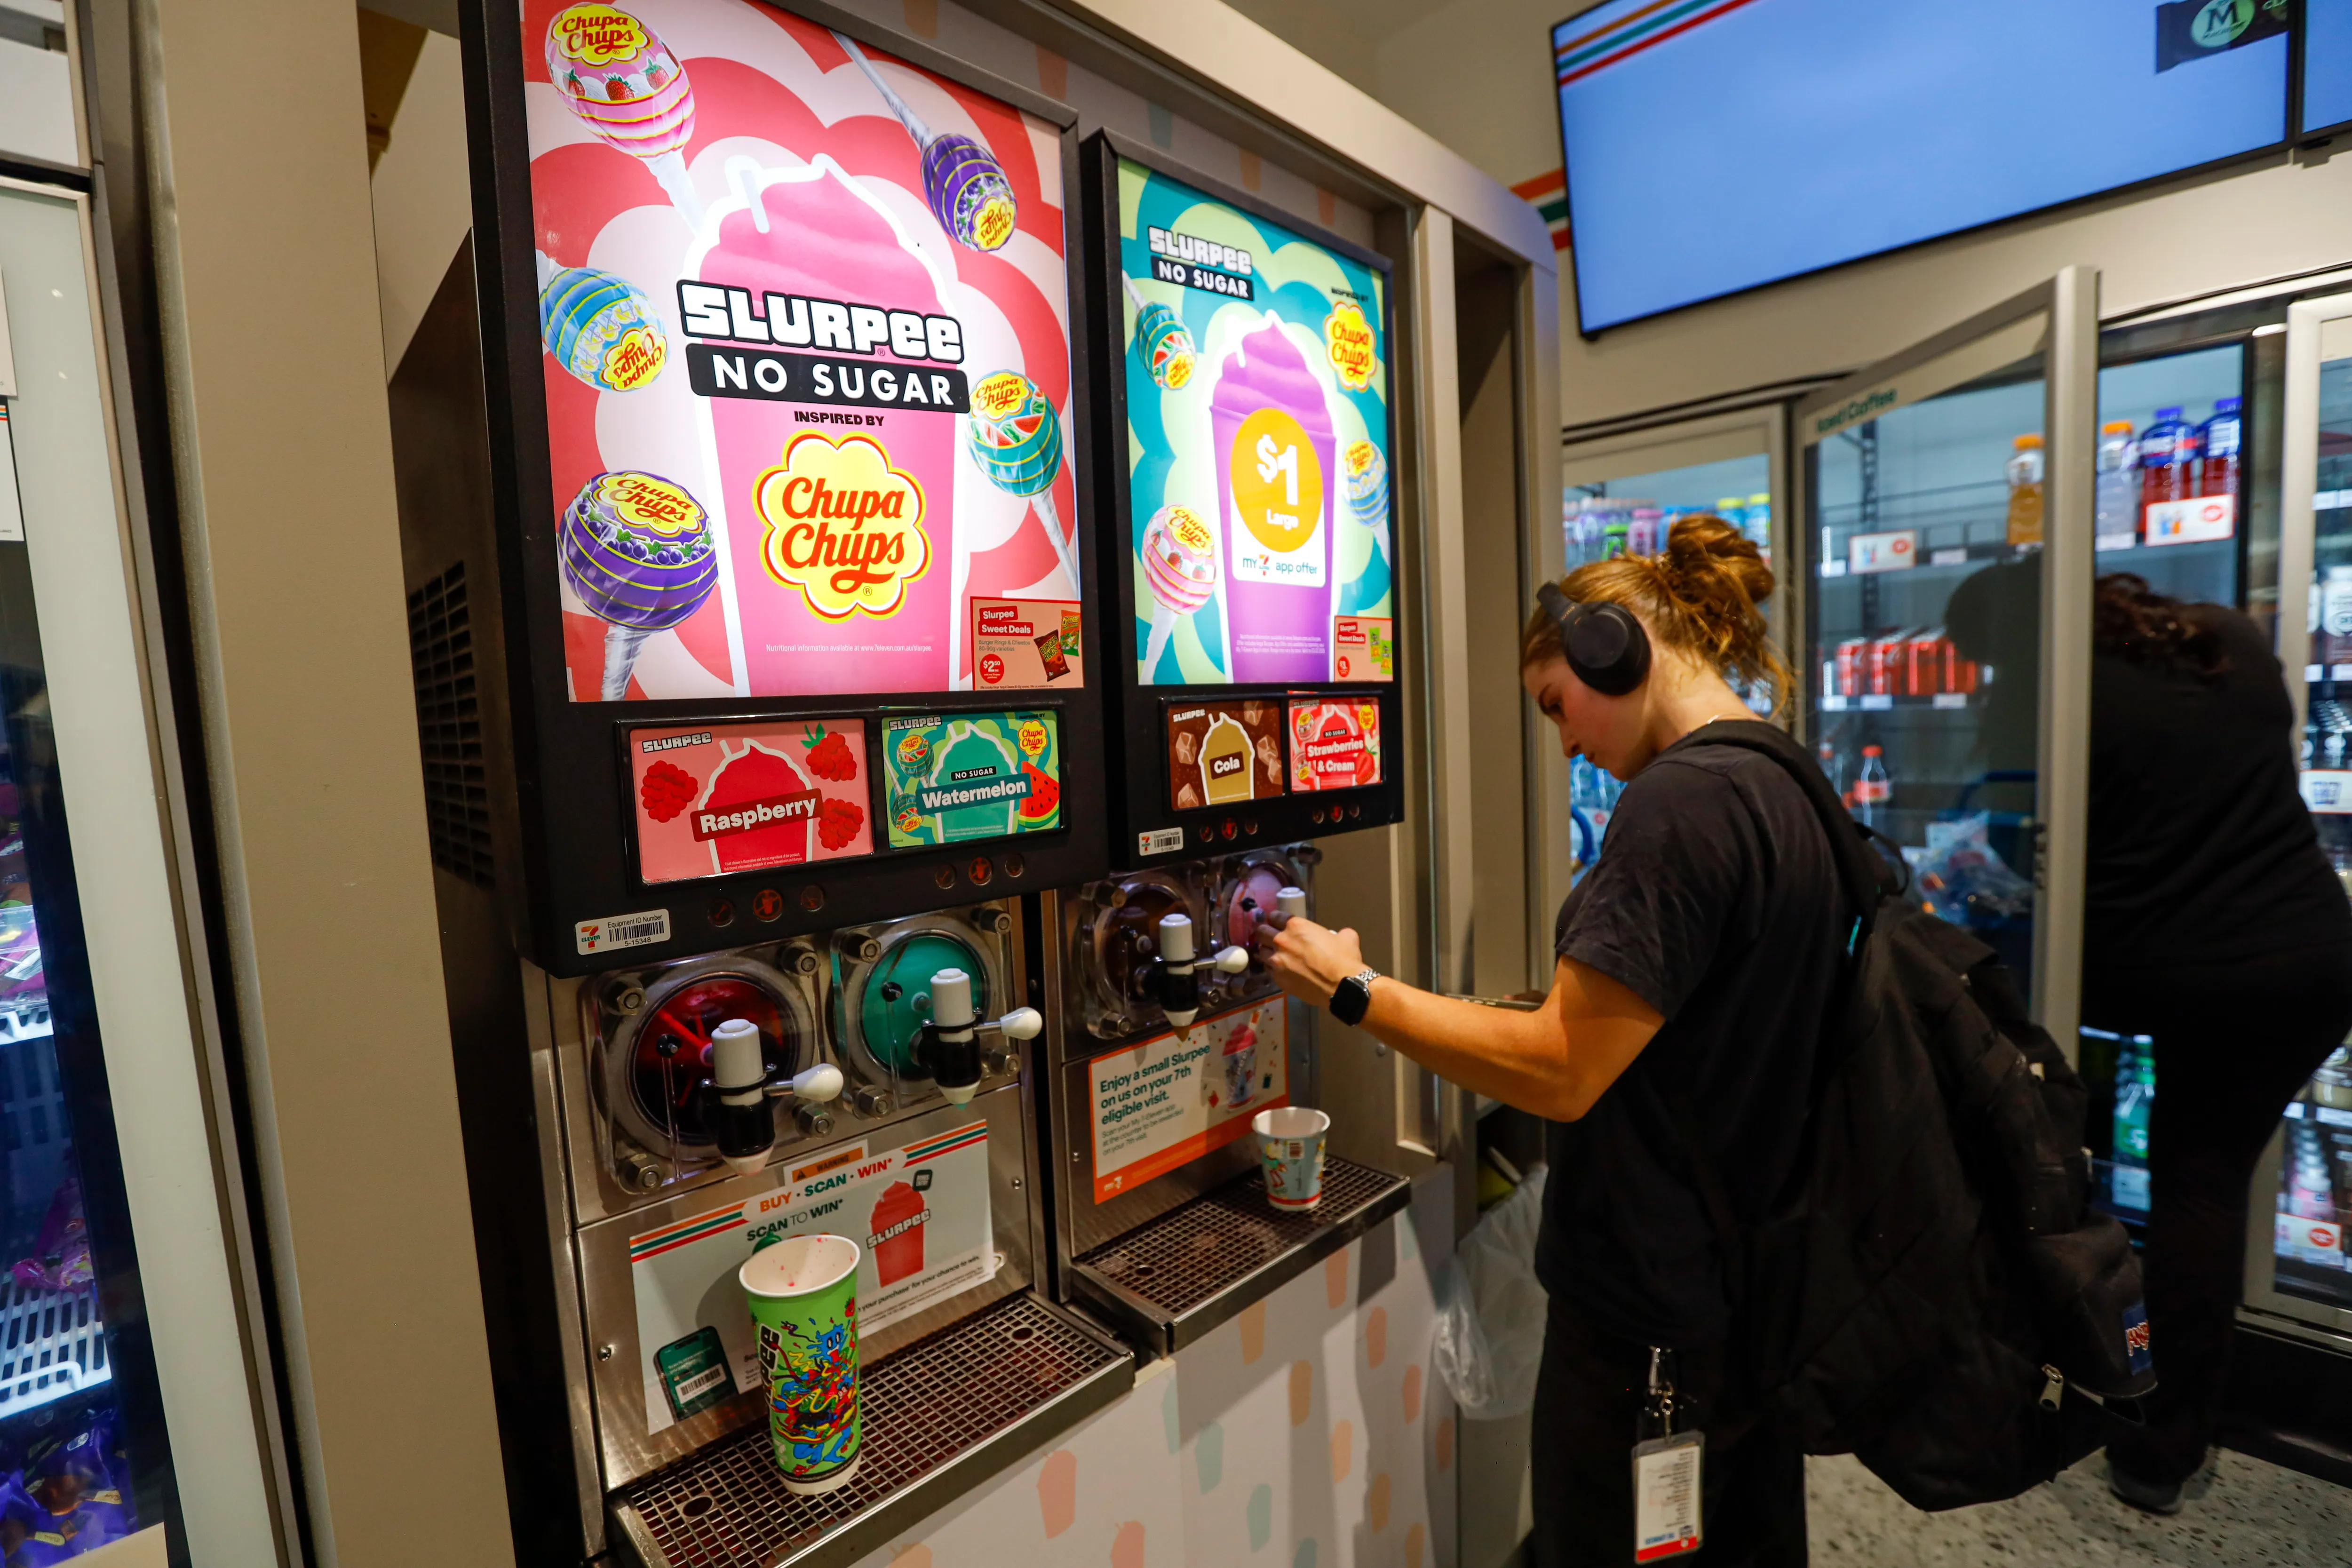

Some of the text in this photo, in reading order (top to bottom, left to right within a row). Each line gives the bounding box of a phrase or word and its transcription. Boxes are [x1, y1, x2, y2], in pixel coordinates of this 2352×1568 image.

[562, 16, 629, 32] Chupa
[566, 29, 635, 55] Chups
[1158, 261, 1249, 299] NO SUGAR
[1332, 321, 1369, 349] Chupa
[613, 333, 655, 379] Chups
[621, 345, 662, 388] Chupa
[1332, 342, 1369, 377] Chups
[711, 354, 954, 406] NO SUGAR
[976, 378, 1019, 398] Chupa
[977, 387, 1021, 411] Chups
[794, 410, 885, 427] INSPIRED BY
[1255, 434, 1298, 506] $1
[609, 489, 687, 523] Chups
[617, 479, 693, 510] Chupa
[782, 476, 906, 531] Chupa
[1175, 509, 1210, 540] Chupa
[1266, 509, 1299, 531] Large
[1169, 517, 1206, 549] Chups
[781, 522, 905, 594] Chups
[1275, 562, 1294, 575] app
[1296, 562, 1318, 574] offer
[983, 611, 1015, 621] Slurpee
[981, 624, 1031, 634] Sweet Deals
[766, 644, 796, 652] Nutritional
[860, 644, 933, 653] www.7eleven.com.au/slurpee.
[1039, 635, 1058, 655] BURGER
[1043, 646, 1058, 662] RINGS
[902, 740, 919, 750] Chups
[1022, 729, 1043, 739] Chupa
[1022, 738, 1043, 751] Chups
[1307, 738, 1364, 757] Strawberries
[969, 768, 993, 777] SUGAR
[1214, 757, 1240, 774] Cola
[1318, 760, 1355, 772] & Cream
[922, 780, 1026, 809] Watermelon
[699, 797, 817, 834] Raspberry
[607, 919, 635, 929] Equipment
[581, 925, 599, 948] 7
[624, 937, 652, 947] 5-15348
[1100, 1044, 1211, 1093] Enjoy a small Slurpee
[1100, 1065, 1191, 1109] on us on your 7th
[1101, 1090, 1170, 1125] eligible visit.
[816, 1154, 850, 1172] WARNING
[759, 1191, 792, 1213] BUY
[804, 1173, 847, 1197] SCAN
[746, 1218, 788, 1242] SCAN
[789, 1210, 808, 1226] TO
